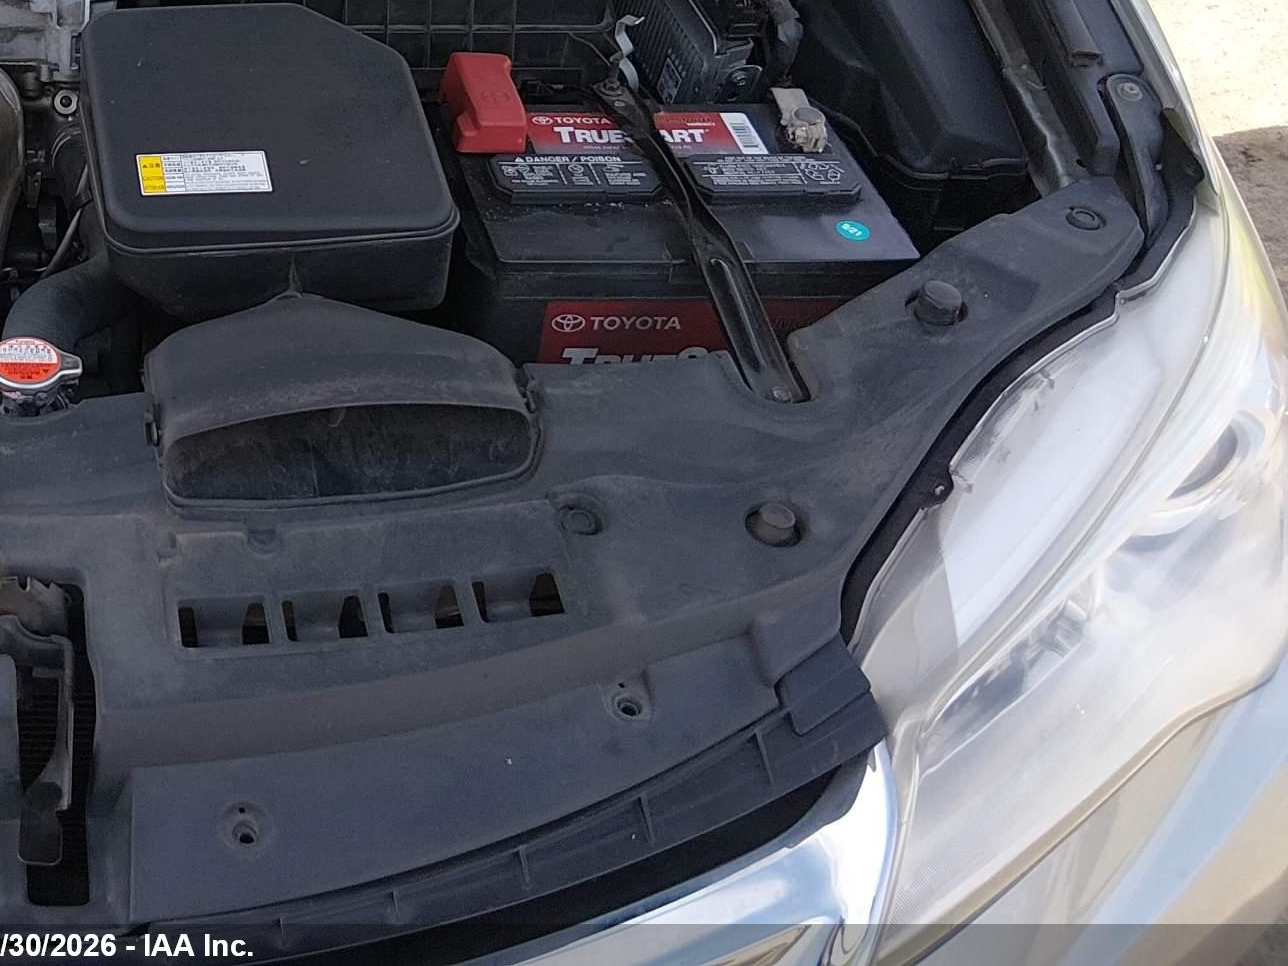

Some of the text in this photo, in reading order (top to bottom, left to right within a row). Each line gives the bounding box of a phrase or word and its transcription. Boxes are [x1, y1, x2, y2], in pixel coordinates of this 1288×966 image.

[554, 116, 611, 125] TOYOTA
[525, 155, 569, 163] DANGER
[580, 155, 622, 163] POISON
[589, 316, 681, 330] TOYOTA
